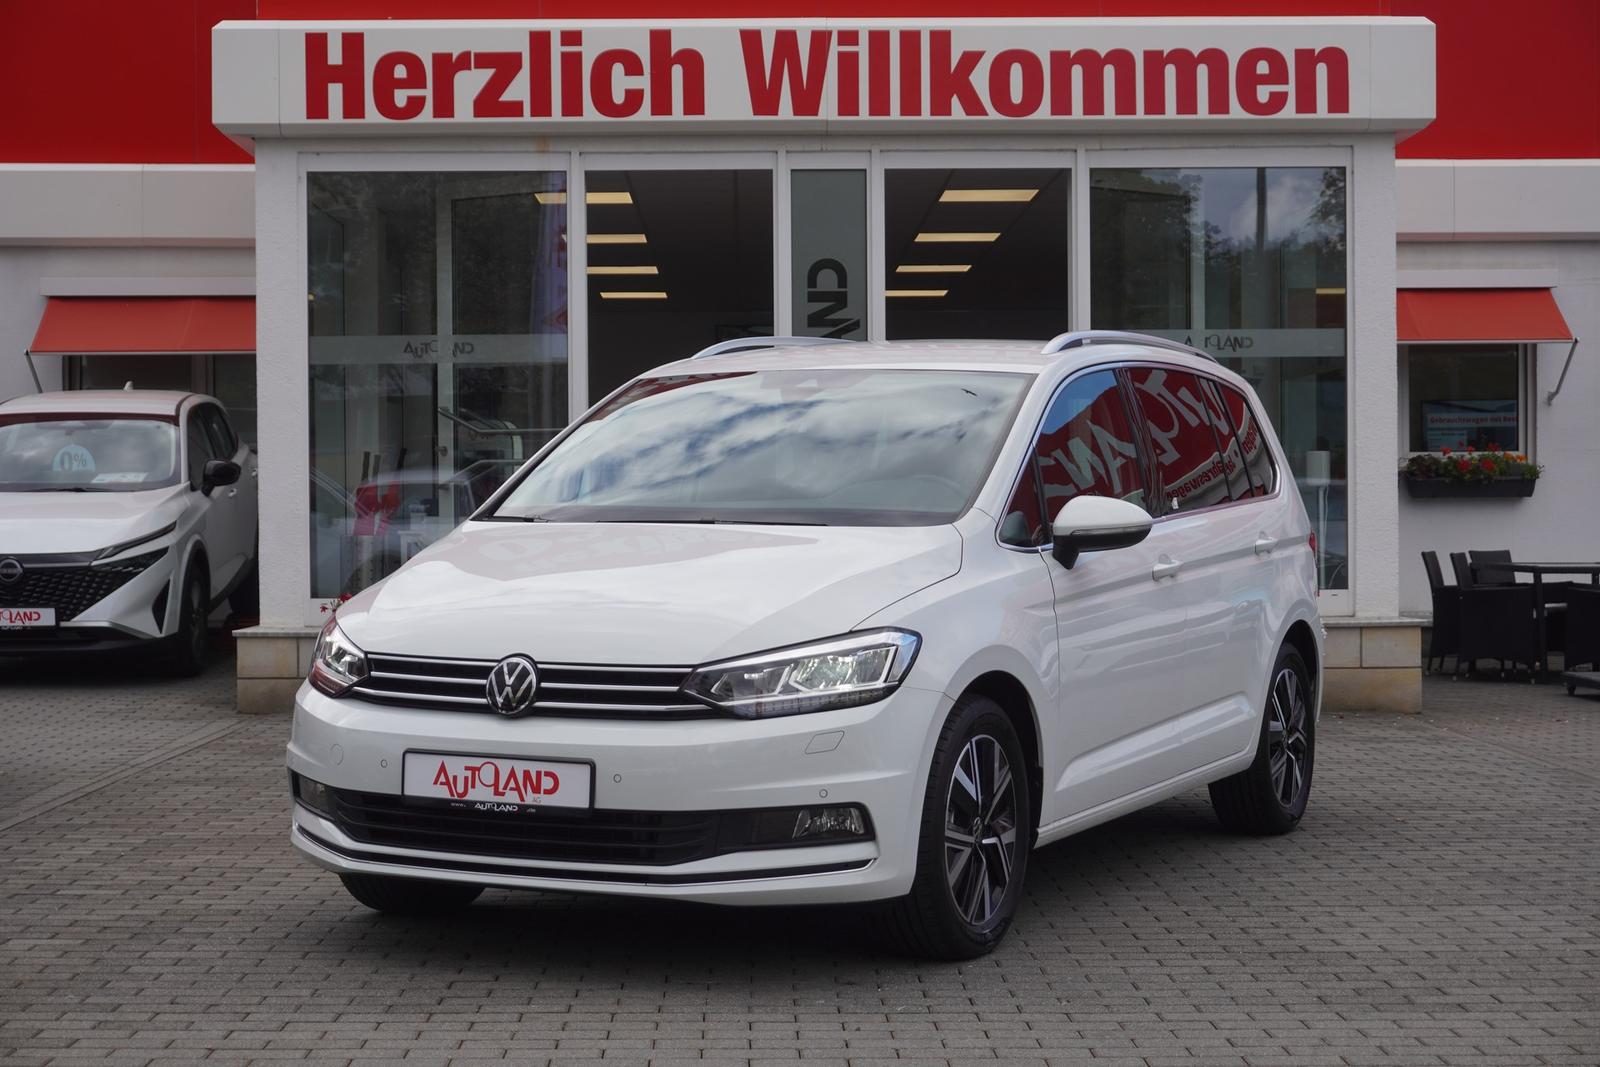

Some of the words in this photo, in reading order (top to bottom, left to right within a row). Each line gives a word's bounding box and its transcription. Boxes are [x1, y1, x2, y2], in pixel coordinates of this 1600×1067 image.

[305, 29, 705, 120] Herzlich
[739, 28, 1350, 118] Willkommen
[403, 340, 474, 358] AUTOND
[1184, 334, 1254, 352] ATOLAND
[433, 760, 560, 802] AUTOLAND
